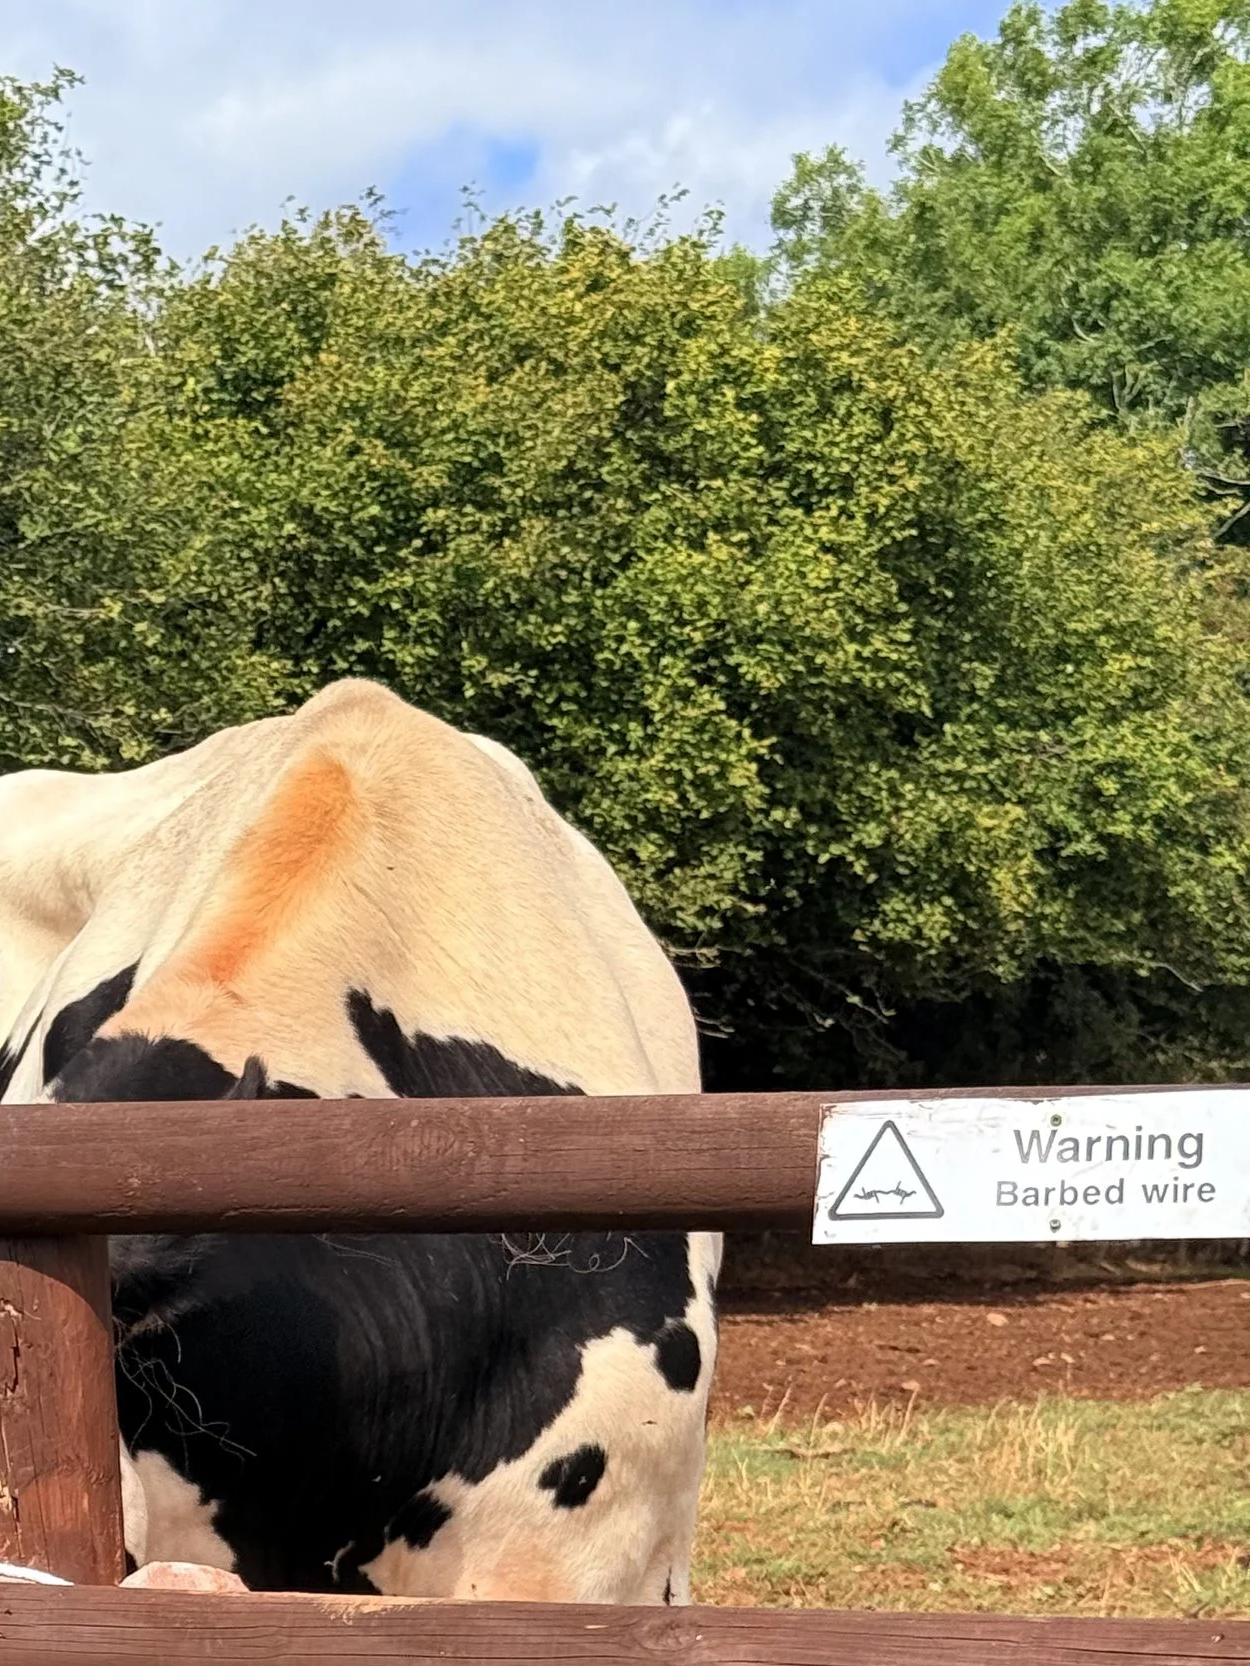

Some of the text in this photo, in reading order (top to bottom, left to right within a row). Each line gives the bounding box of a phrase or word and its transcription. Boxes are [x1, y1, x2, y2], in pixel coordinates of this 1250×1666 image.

[1013, 1125, 1204, 1169] Warning
[996, 1176, 1217, 1207] Barbed wire
